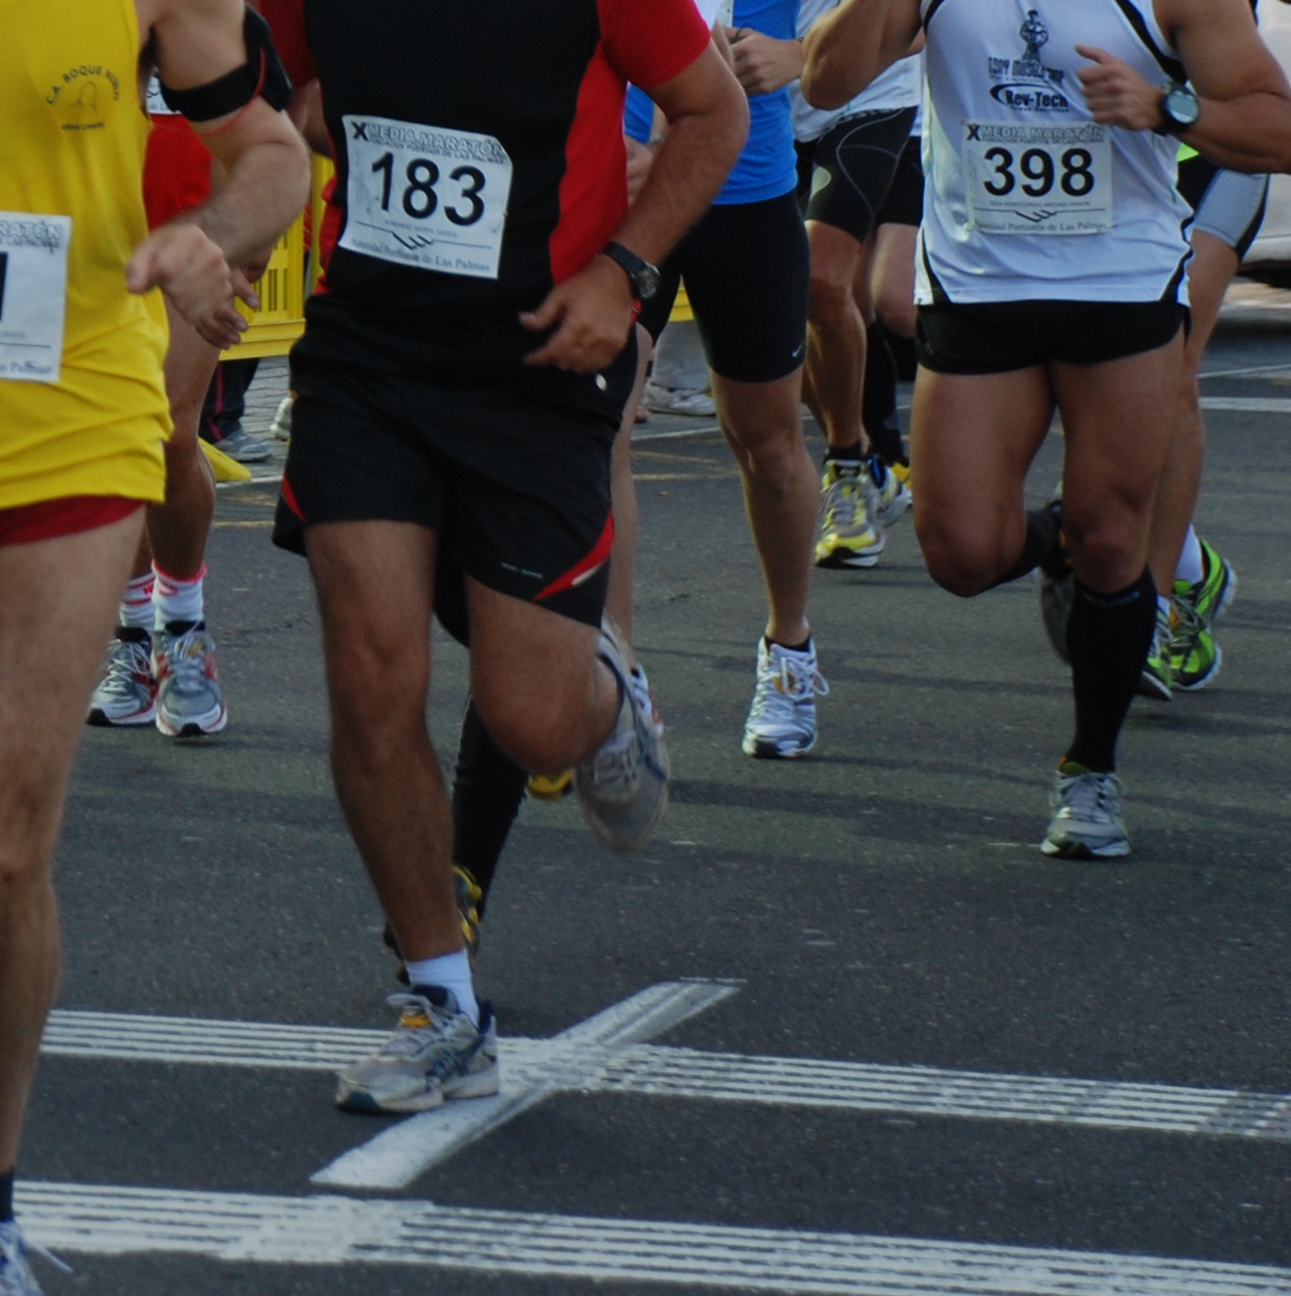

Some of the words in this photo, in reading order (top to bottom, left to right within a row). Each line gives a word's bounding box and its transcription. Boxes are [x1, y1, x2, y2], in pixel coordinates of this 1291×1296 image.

[352, 122, 369, 141] X
[369, 123, 418, 142] MEDIA
[422, 131, 507, 158] MARATÓN
[966, 124, 981, 141] X
[982, 126, 1026, 140] MEDIA
[1029, 124, 1105, 141] MARATÓN
[983, 146, 1095, 197] 398
[372, 151, 486, 227] 183
[1046, 222, 1057, 231] de
[1061, 222, 1076, 231] Las
[435, 254, 452, 268] Las
[456, 257, 490, 273] Palmas
[10, 360, 52, 375] Palmas
